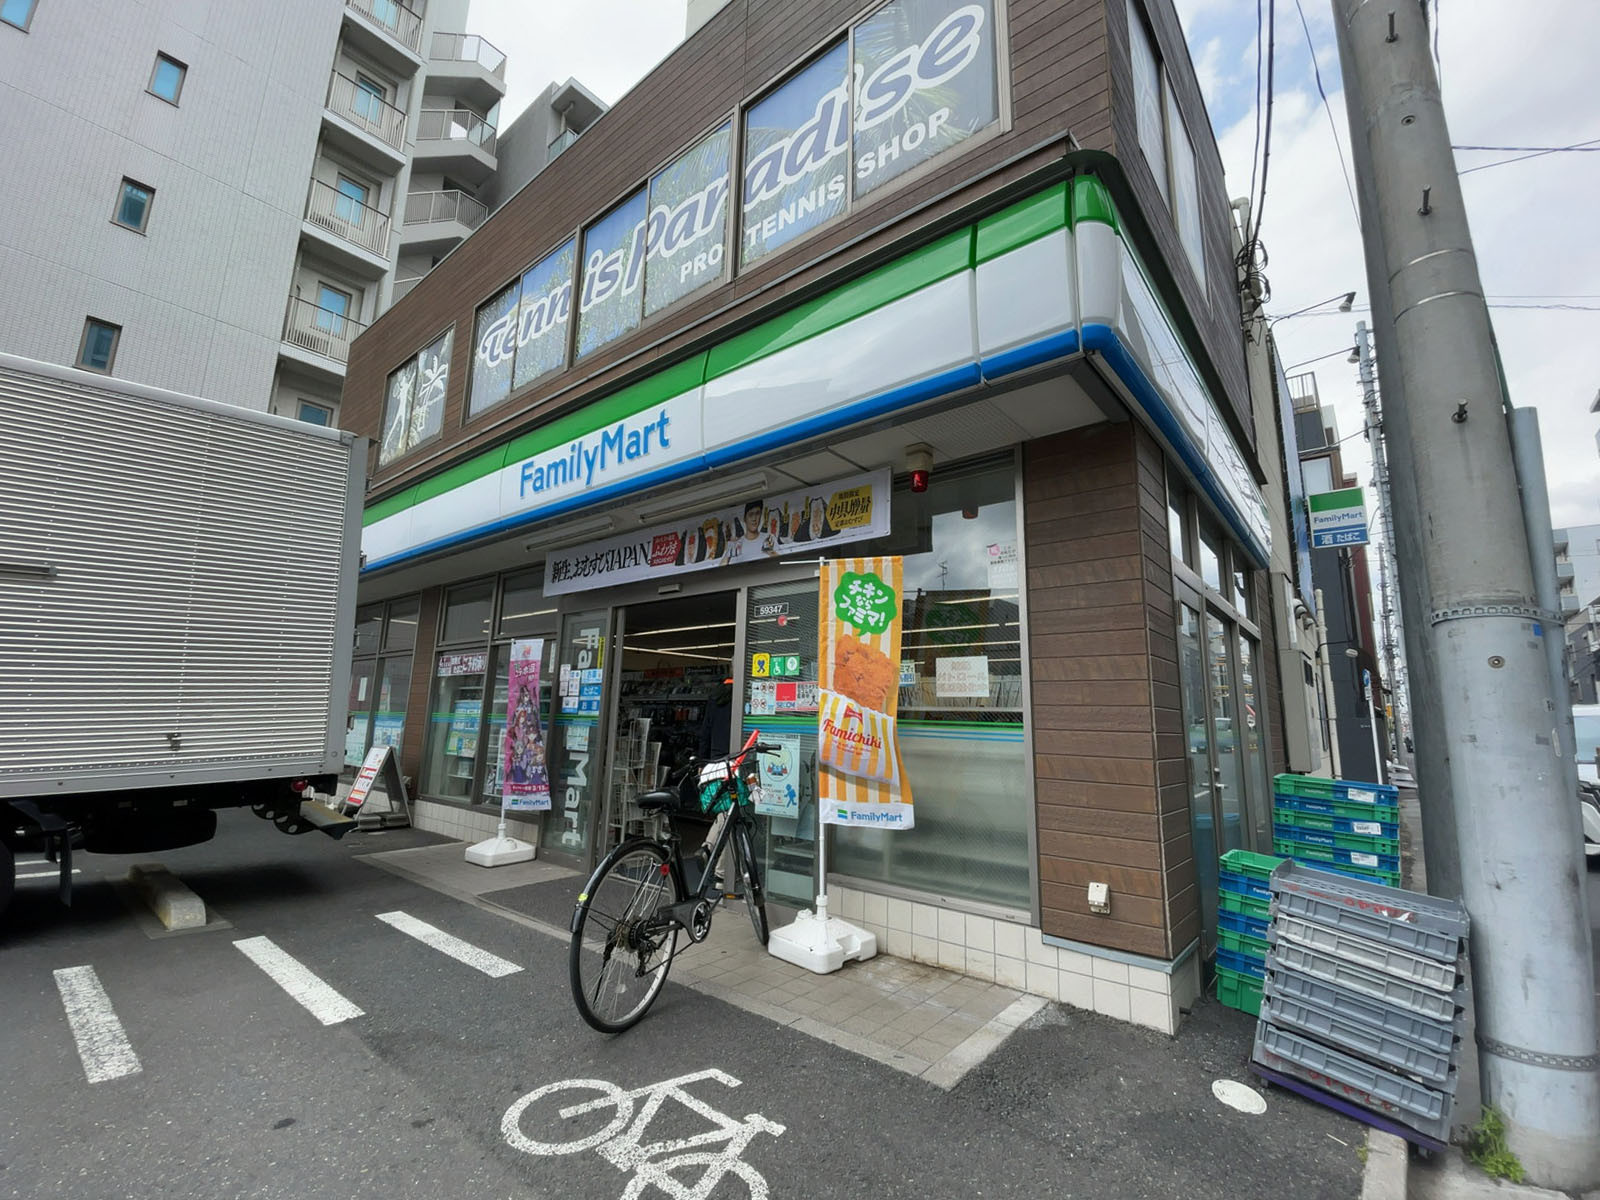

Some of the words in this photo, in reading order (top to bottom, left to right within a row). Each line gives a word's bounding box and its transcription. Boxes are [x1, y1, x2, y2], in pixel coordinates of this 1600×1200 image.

[477, 248, 623, 368] Tennis
[620, 3, 985, 297] Paradise
[680, 243, 723, 284] PRO
[746, 174, 846, 247] TENNIS
[857, 107, 951, 180] SHOP
[520, 409, 670, 498] FamilyMart
[1313, 512, 1362, 523] FamilyMart
[1321, 534, 1333, 545] 酒
[1336, 532, 1361, 543] たばこ
[848, 580, 889, 604] チキン
[855, 595, 873, 609] なら
[760, 605, 782, 616] 59347
[775, 701, 796, 709] SECOM
[823, 718, 882, 749] Famichiki
[850, 811, 903, 822] FamilyMart
[1305, 835, 1333, 844] FamilyMart
